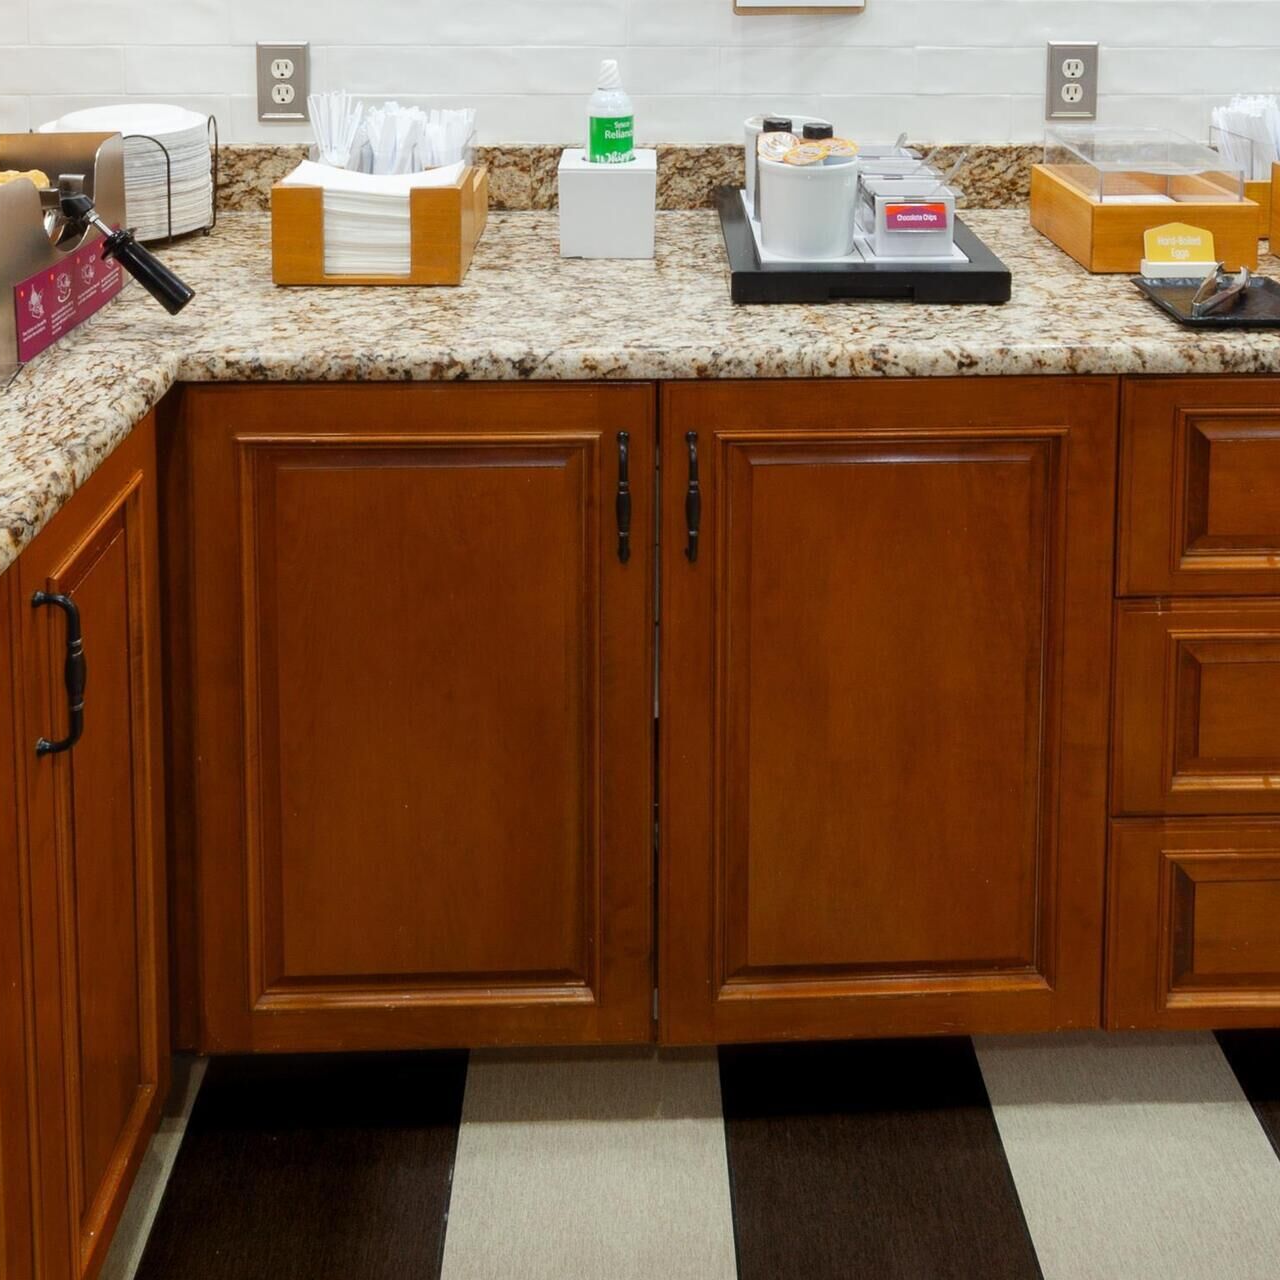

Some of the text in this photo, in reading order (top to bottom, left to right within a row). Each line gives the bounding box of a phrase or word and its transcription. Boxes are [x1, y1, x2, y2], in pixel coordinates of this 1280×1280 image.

[923, 214, 937, 222] Chips
[1157, 235, 1201, 245] Hard-Boiled
[1171, 248, 1190, 259] Eggs
